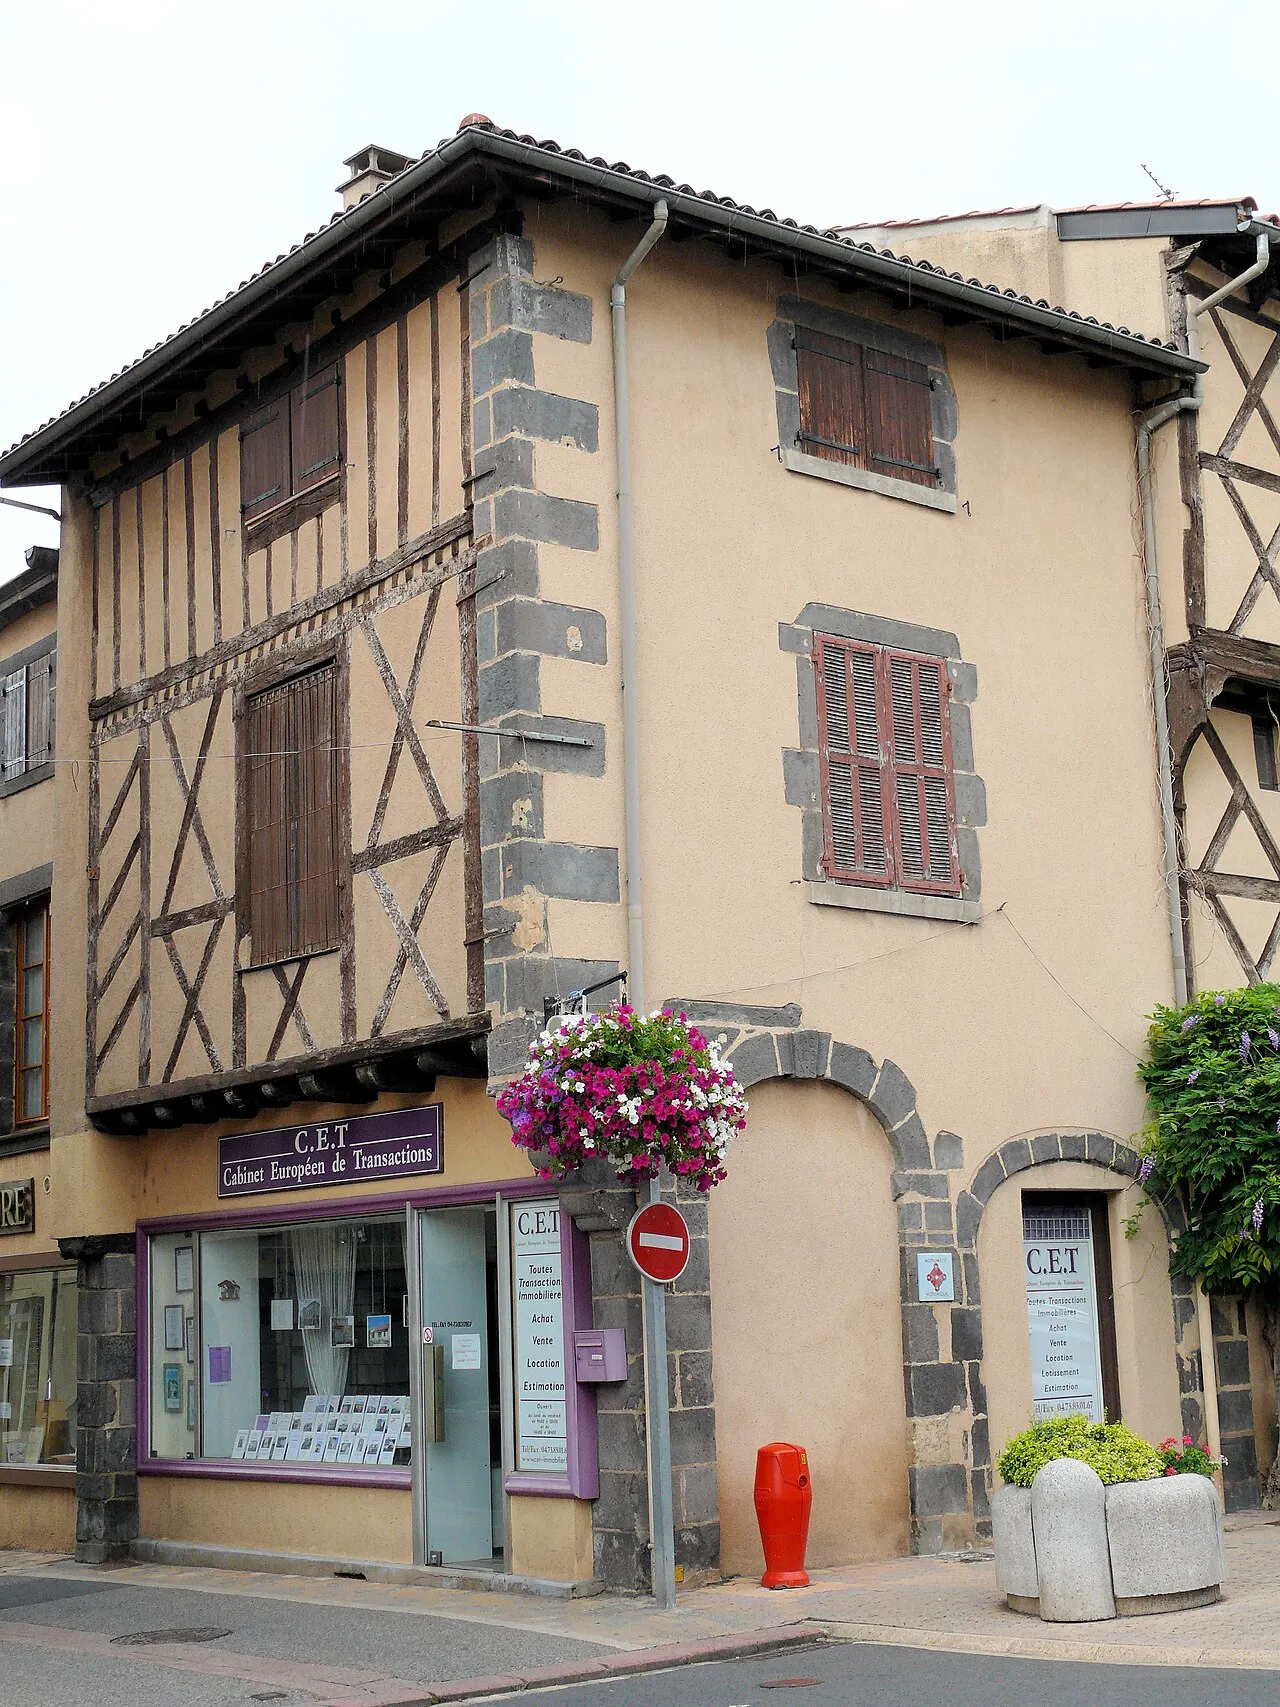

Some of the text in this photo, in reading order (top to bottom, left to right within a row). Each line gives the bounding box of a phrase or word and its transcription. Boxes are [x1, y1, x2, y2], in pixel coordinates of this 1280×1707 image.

[294, 1123, 349, 1155] C.E.T
[223, 1143, 433, 1187] Cabinet Européen de Transactions
[517, 1210, 560, 1236] C.E.T
[1026, 1247, 1078, 1275] C.E.T
[529, 1265, 553, 1274] Toutes
[1049, 1296, 1087, 1305] Transactions
[1037, 1308, 1077, 1317] Immobilières
[531, 1314, 554, 1323] Achat
[1049, 1324, 1067, 1332] Achat
[532, 1336, 554, 1345] Vente
[1049, 1339, 1067, 1347] Vente
[1045, 1354, 1074, 1362] Location
[527, 1358, 560, 1368] Location
[1041, 1368, 1080, 1378] Lotissement
[523, 1381, 565, 1391] Estimation
[1044, 1383, 1079, 1393] Estimation
